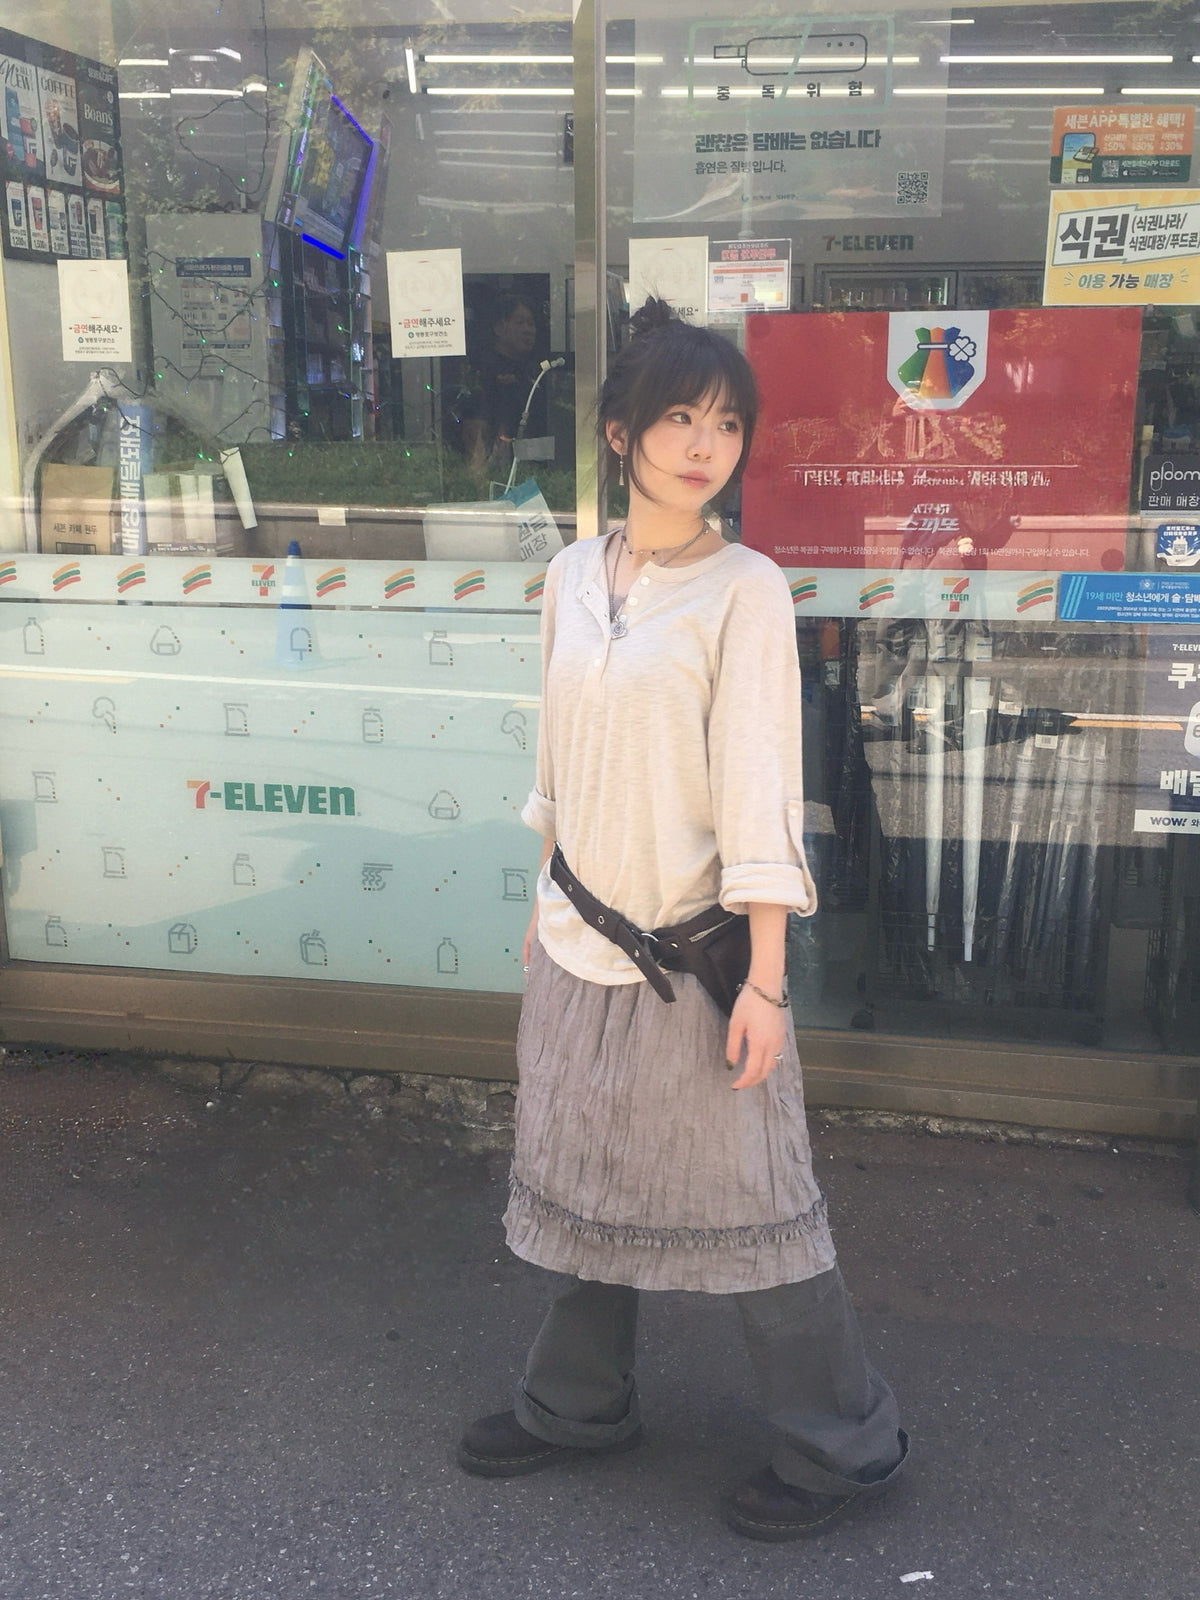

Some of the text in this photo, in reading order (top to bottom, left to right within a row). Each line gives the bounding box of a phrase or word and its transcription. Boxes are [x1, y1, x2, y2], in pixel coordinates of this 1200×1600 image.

[807, 82, 821, 97] 위
[848, 80, 862, 97] 험
[1119, 113, 1153, 128] 특별한
[1157, 112, 1185, 128] 혜택!
[695, 129, 882, 153] 괜찮은 담배는 없습니다
[695, 161, 728, 174] 흡연은
[1131, 212, 1188, 234] (식권나라/
[1060, 213, 1130, 260] 식권
[1078, 273, 1174, 289] 이용 가능 매장
[1148, 495, 1200, 507] 판매 매장
[1086, 591, 1105, 601] 19세
[1106, 591, 1123, 602] 미만
[1126, 591, 1170, 603] 청소년에게
[1168, 662, 1200, 690] 쿠
[1150, 816, 1187, 827] WOW!
